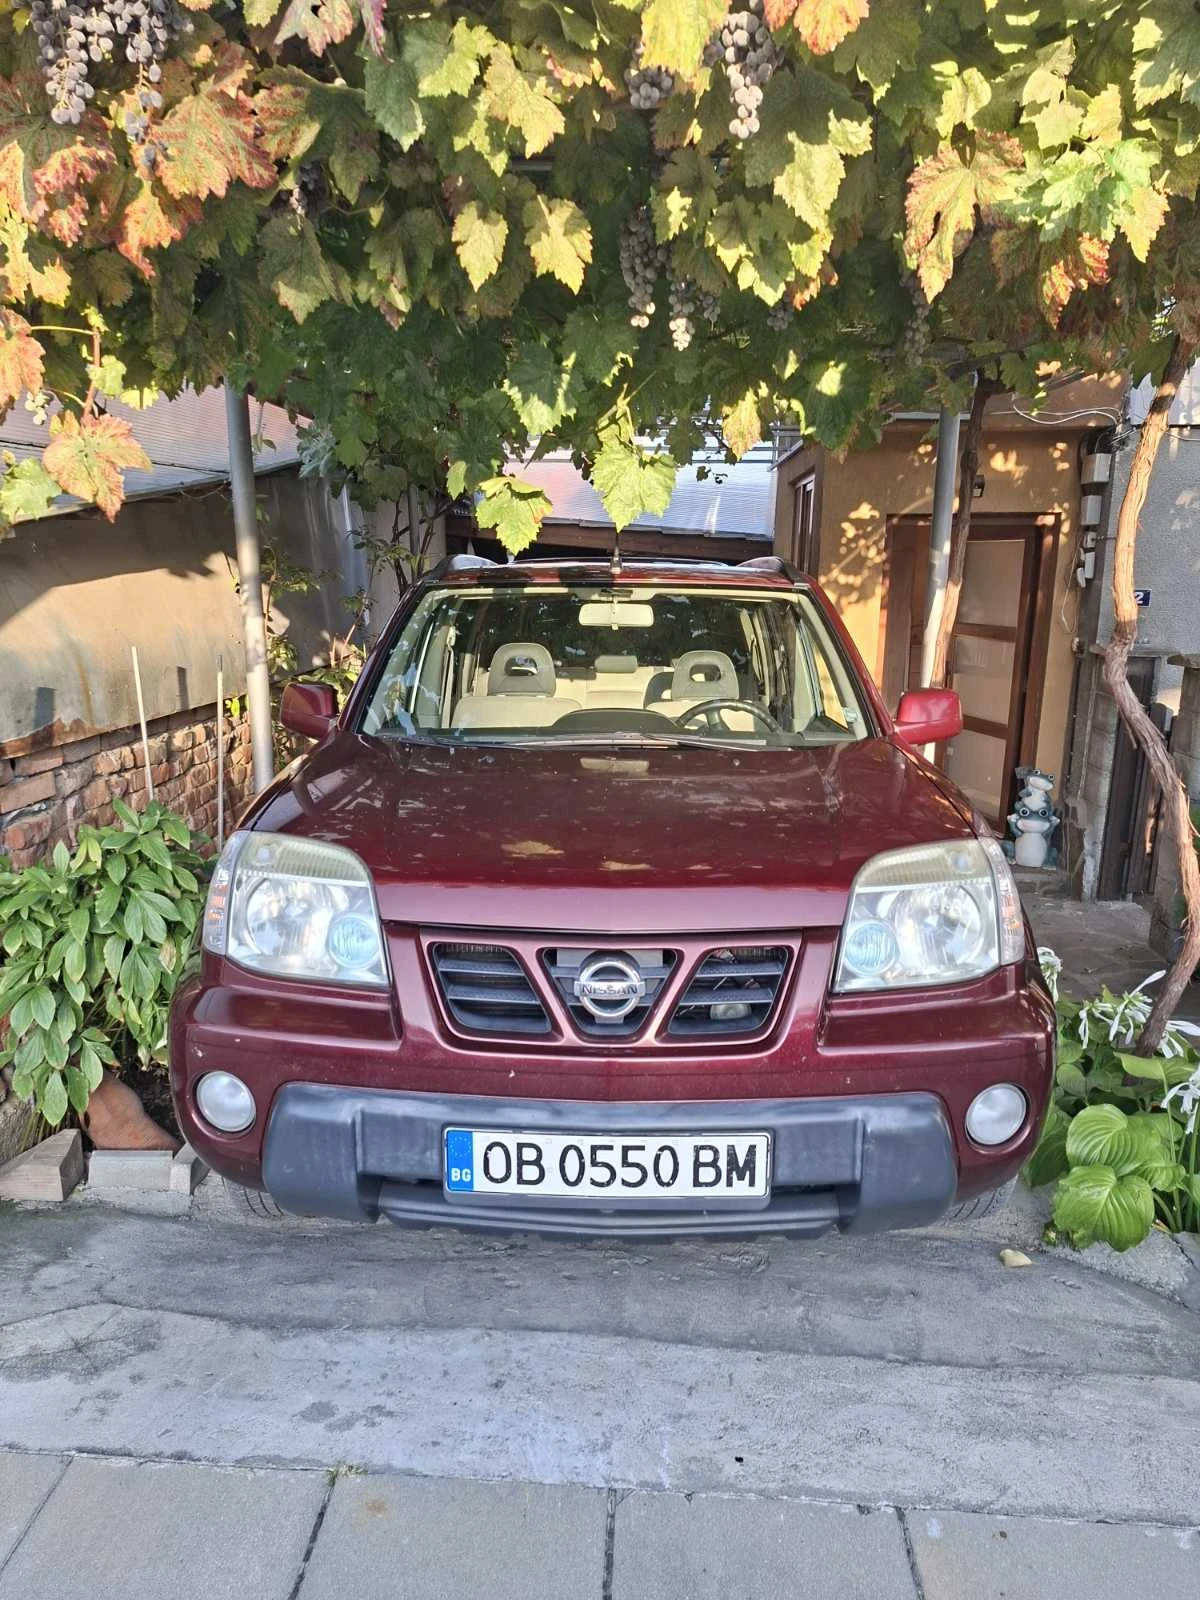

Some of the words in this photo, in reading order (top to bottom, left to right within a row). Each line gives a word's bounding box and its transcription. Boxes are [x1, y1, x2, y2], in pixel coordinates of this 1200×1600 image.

[582, 983, 638, 996] NISSAN
[482, 1141, 546, 1186] OB
[558, 1144, 680, 1188] 0550
[692, 1144, 757, 1188] BM
[451, 1167, 472, 1182] BG
